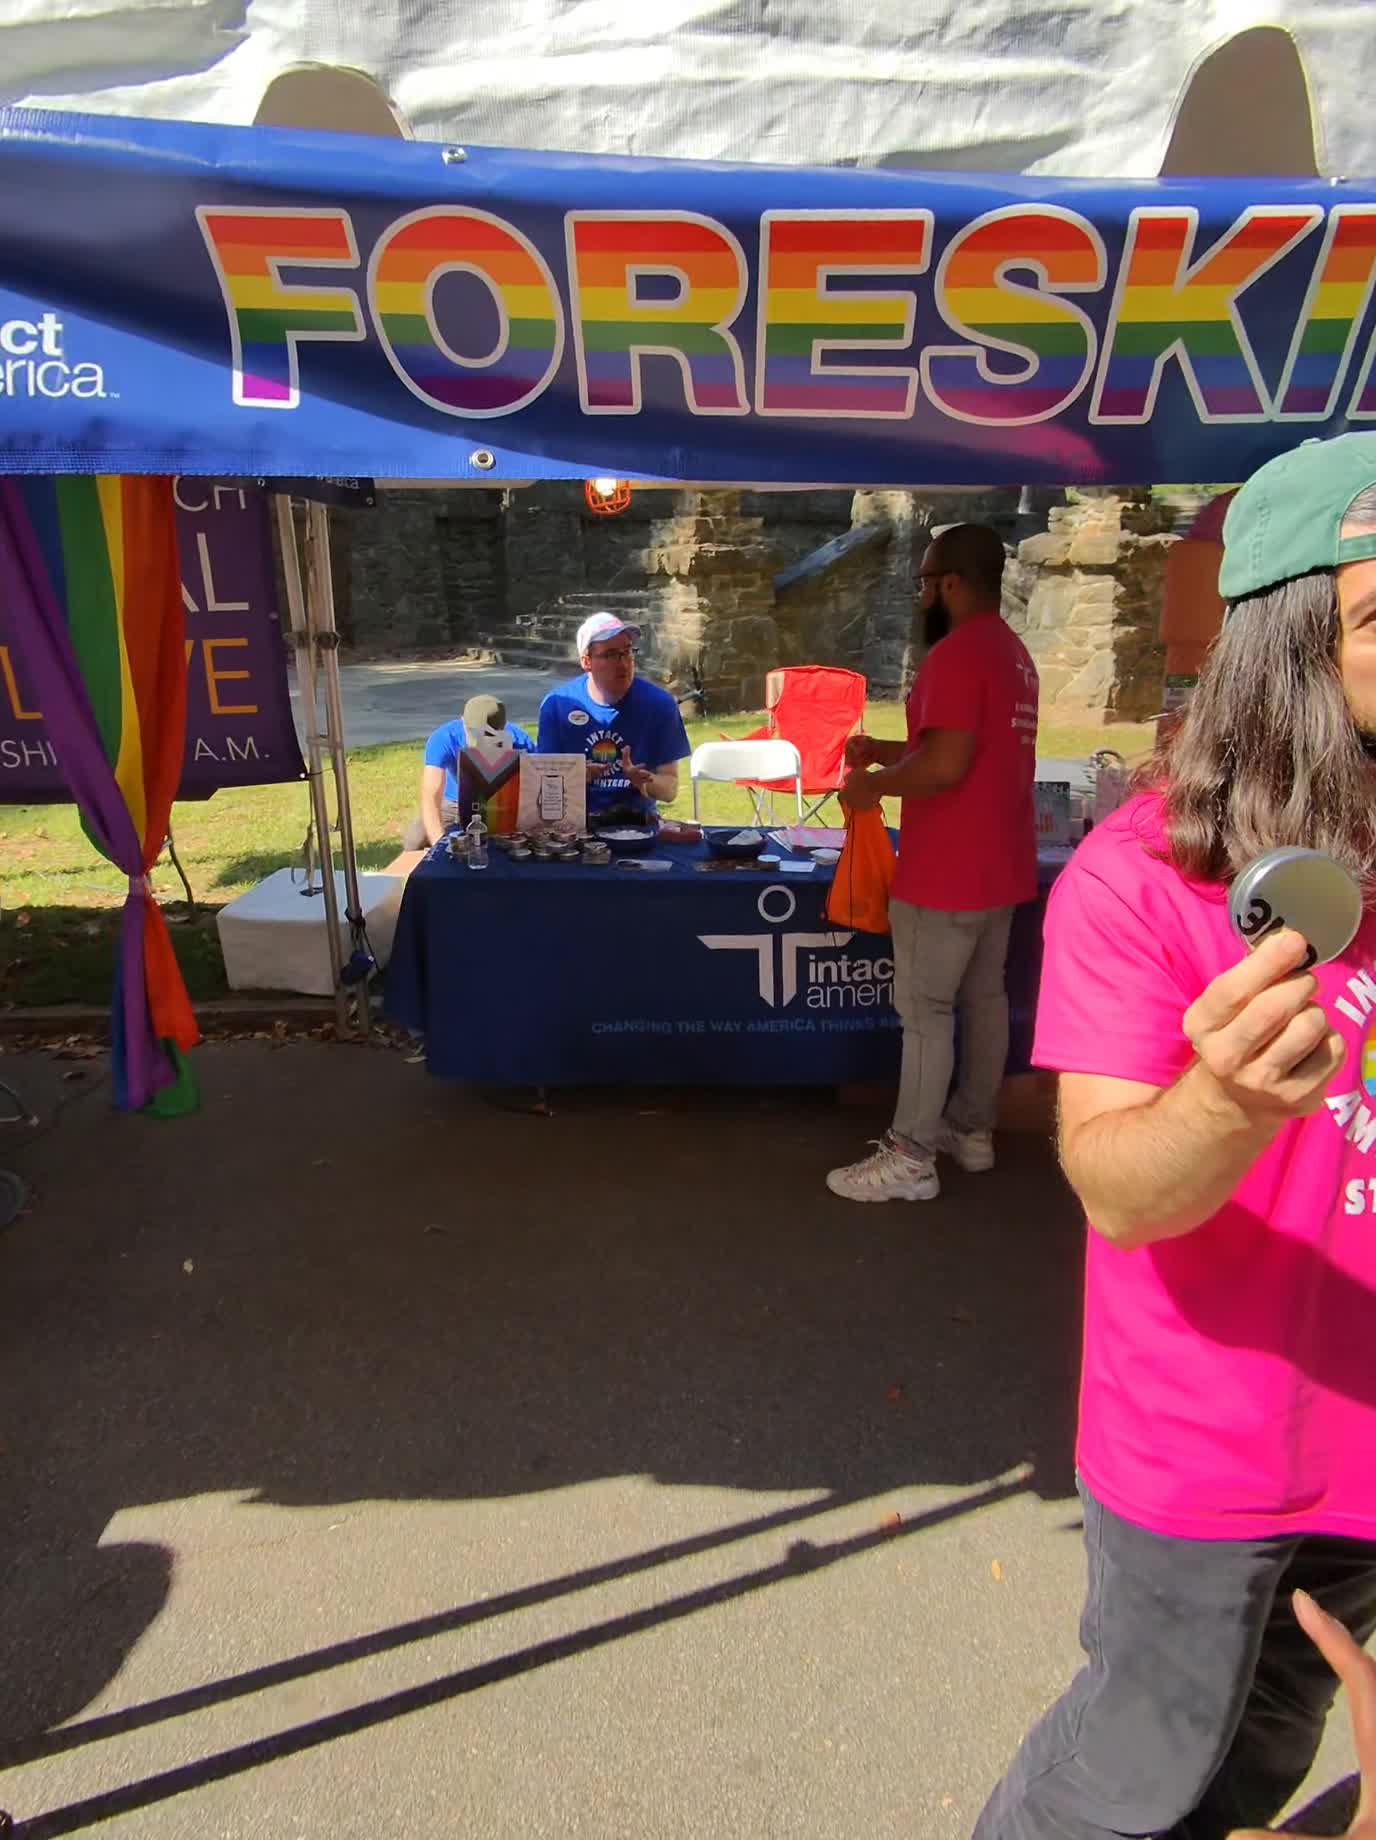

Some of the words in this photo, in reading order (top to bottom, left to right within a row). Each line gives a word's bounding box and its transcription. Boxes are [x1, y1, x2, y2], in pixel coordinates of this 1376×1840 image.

[195, 202, 1376, 427] FORESKI
[0, 359, 107, 398] rica
[195, 736, 270, 761] A.M.
[586, 730, 624, 746] INTACT
[808, 954, 895, 983] intac
[806, 983, 895, 1008] ameri
[676, 1019, 705, 1033] THE
[709, 1018, 744, 1033] WAY
[746, 1016, 816, 1033] AMERICA
